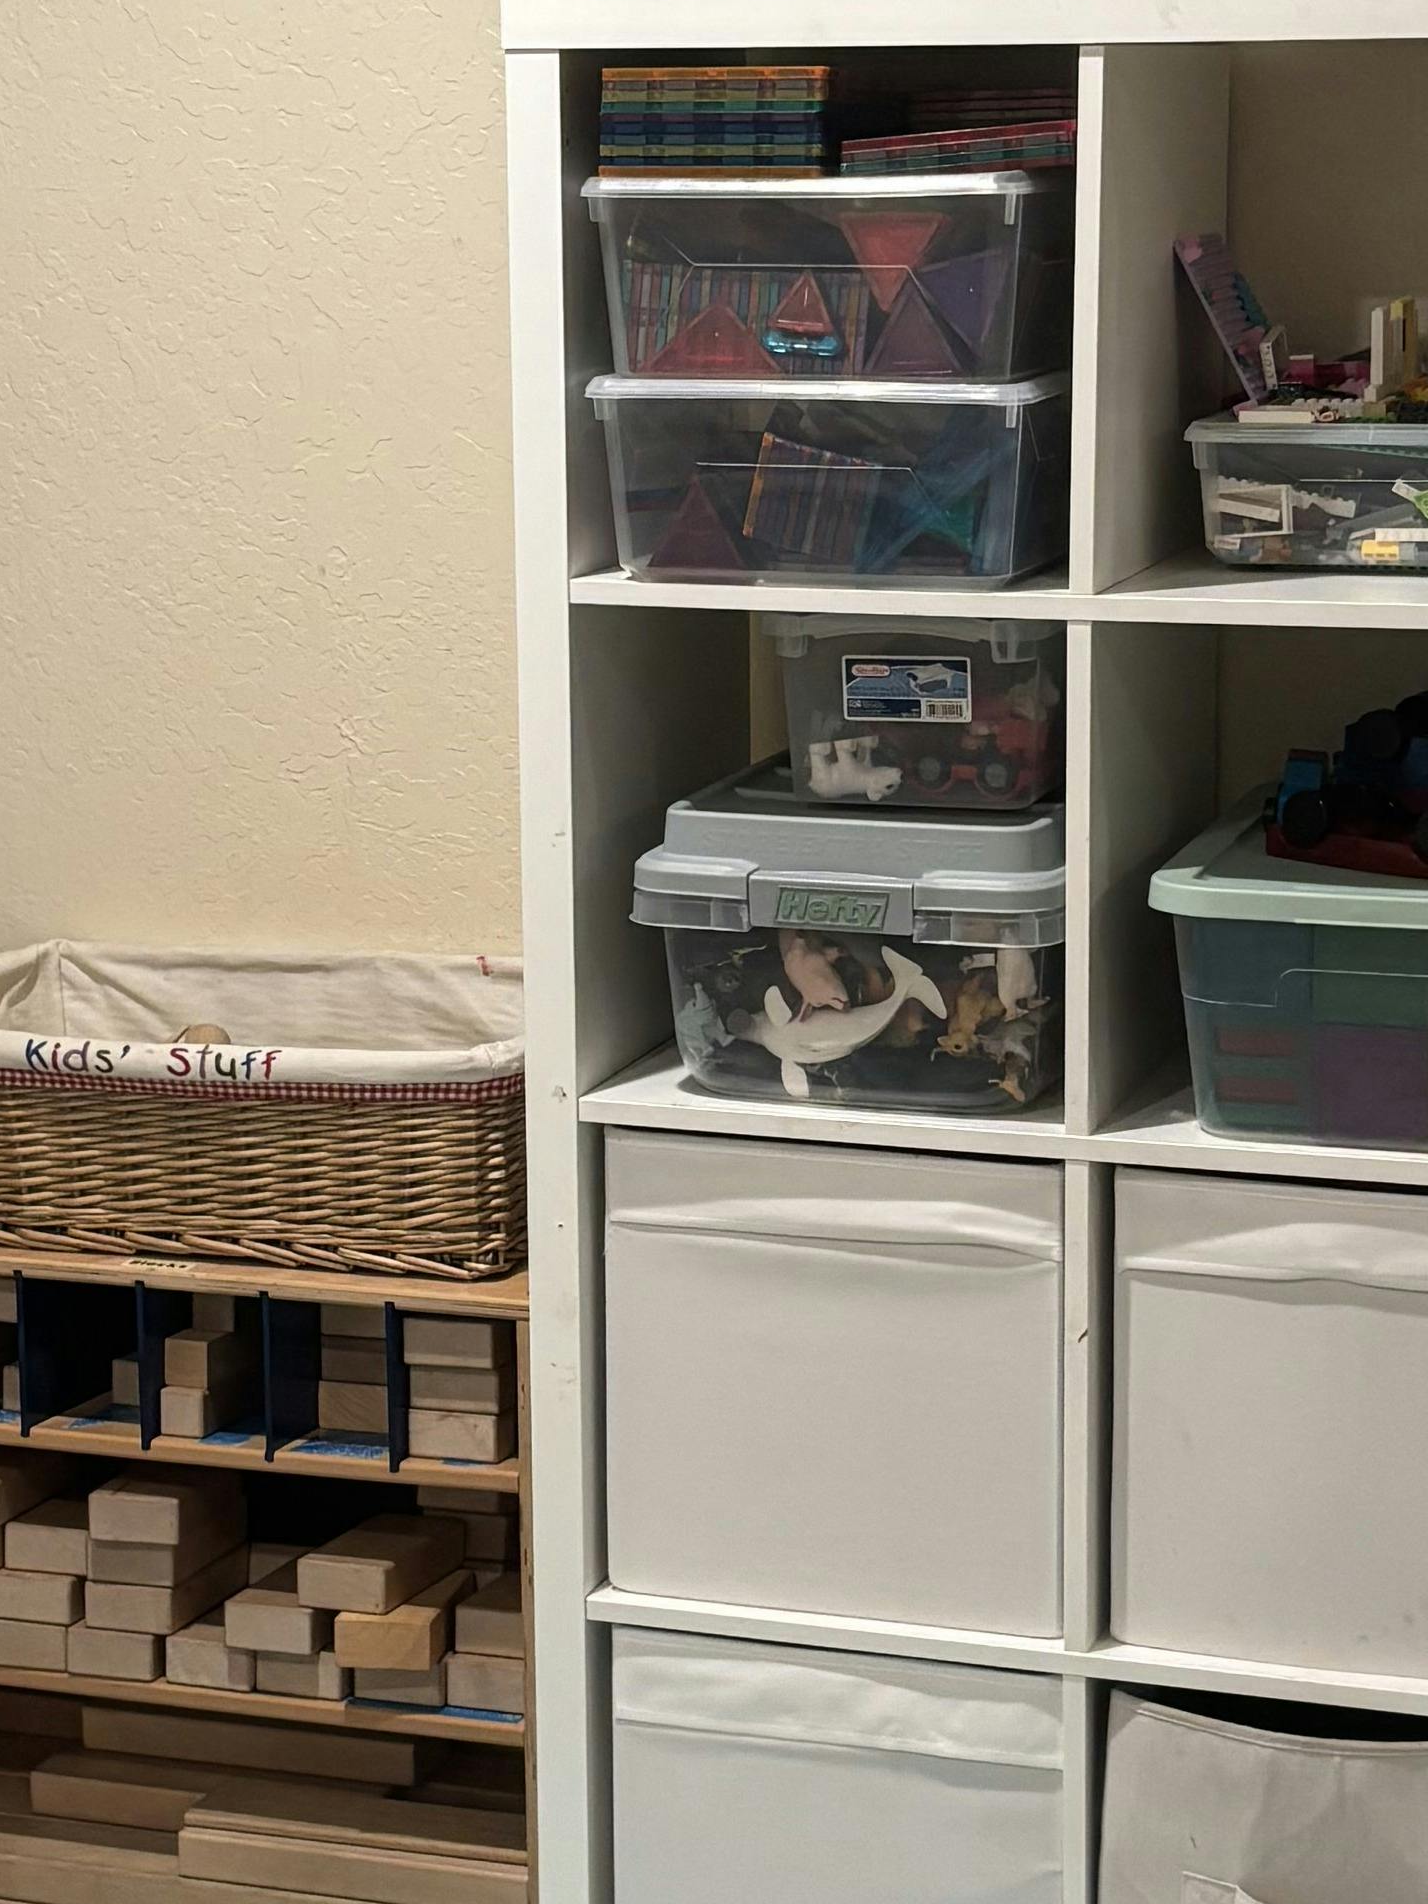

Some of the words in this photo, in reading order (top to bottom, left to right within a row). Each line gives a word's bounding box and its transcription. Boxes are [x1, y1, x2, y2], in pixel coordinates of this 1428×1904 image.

[778, 891, 882, 929] Hefty
[24, 1039, 130, 1074] Kids'
[166, 1045, 282, 1080] Stuff
